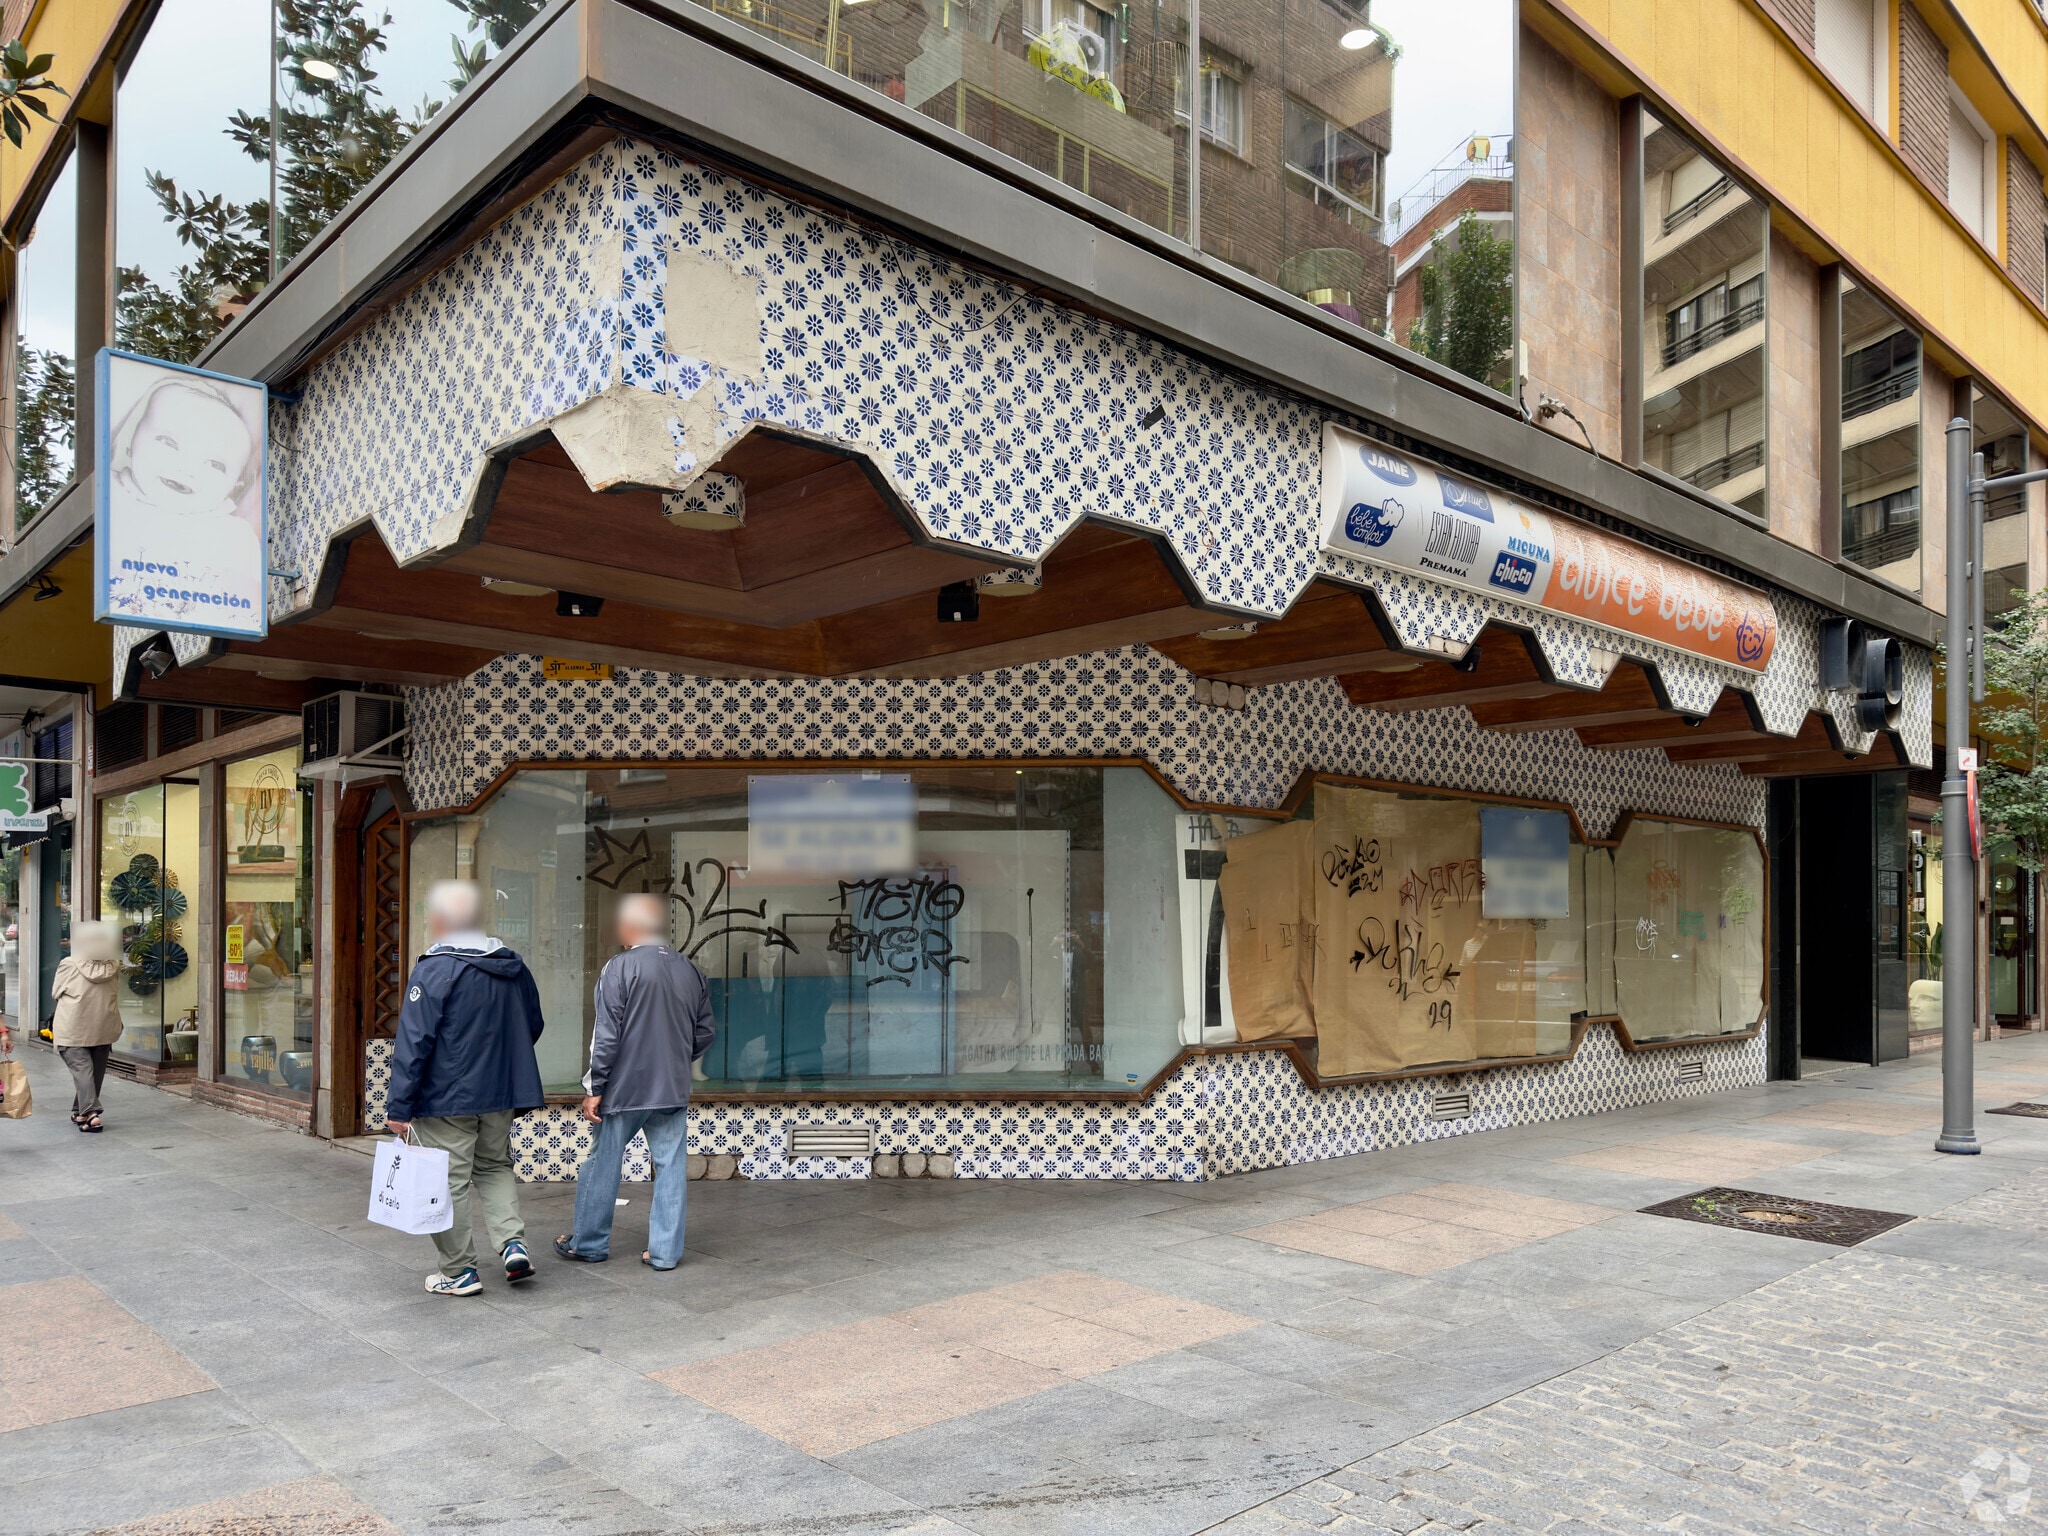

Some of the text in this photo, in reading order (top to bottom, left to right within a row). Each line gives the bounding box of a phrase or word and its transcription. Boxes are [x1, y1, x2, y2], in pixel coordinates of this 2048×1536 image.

[1367, 453, 1410, 478] JANE
[1350, 506, 1374, 528] bébé
[1352, 522, 1384, 548] confort
[1507, 535, 1551, 564] MICUNA
[121, 559, 179, 578] nueva
[1495, 558, 1533, 586] chicco
[143, 584, 251, 609] generación
[1560, 536, 1725, 641] dulce bebé
[225, 969, 248, 984] REBAJAS
[250, 1050, 275, 1074] vajilla
[961, 1044, 1114, 1061] AGATHA RUIZ DE LA PRADA BABY
